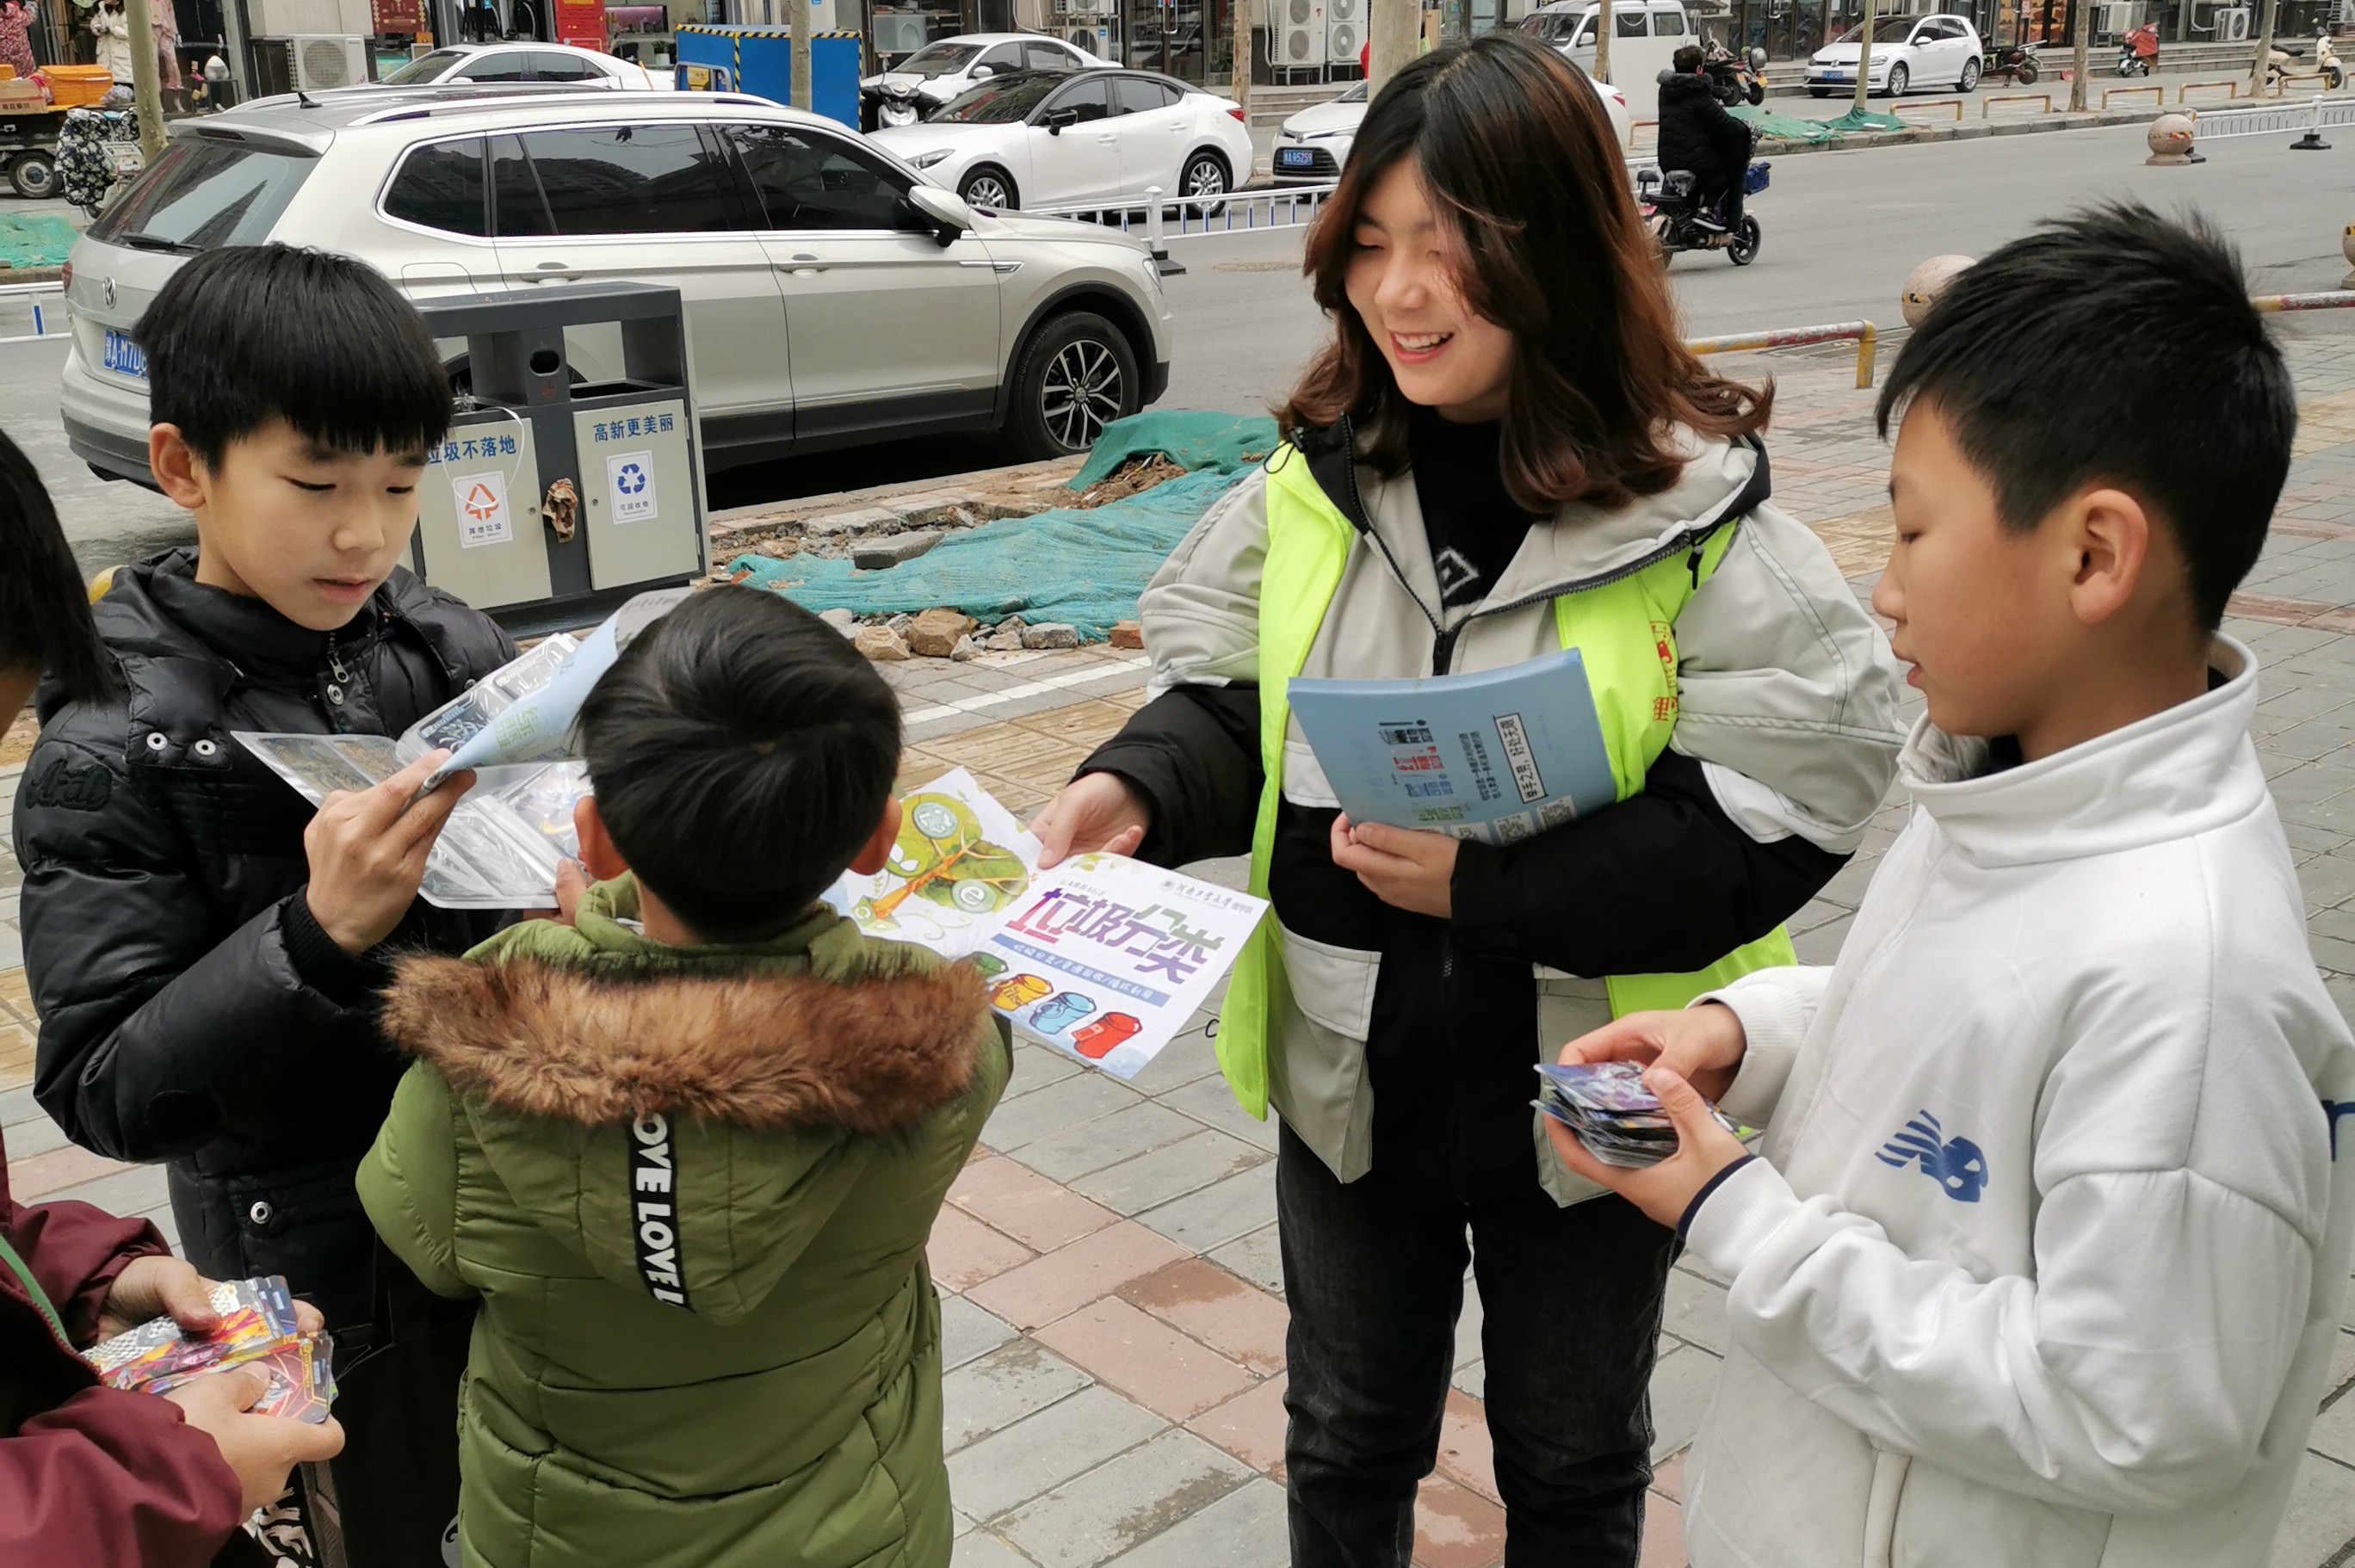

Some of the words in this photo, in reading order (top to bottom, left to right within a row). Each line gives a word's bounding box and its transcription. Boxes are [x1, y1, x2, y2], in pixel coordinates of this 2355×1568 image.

[593, 413, 674, 442] 高新更美丽
[1005, 887, 1226, 985] 垃圾分类
[637, 1202, 680, 1287] LOVE
[652, 1287, 684, 1307] L
